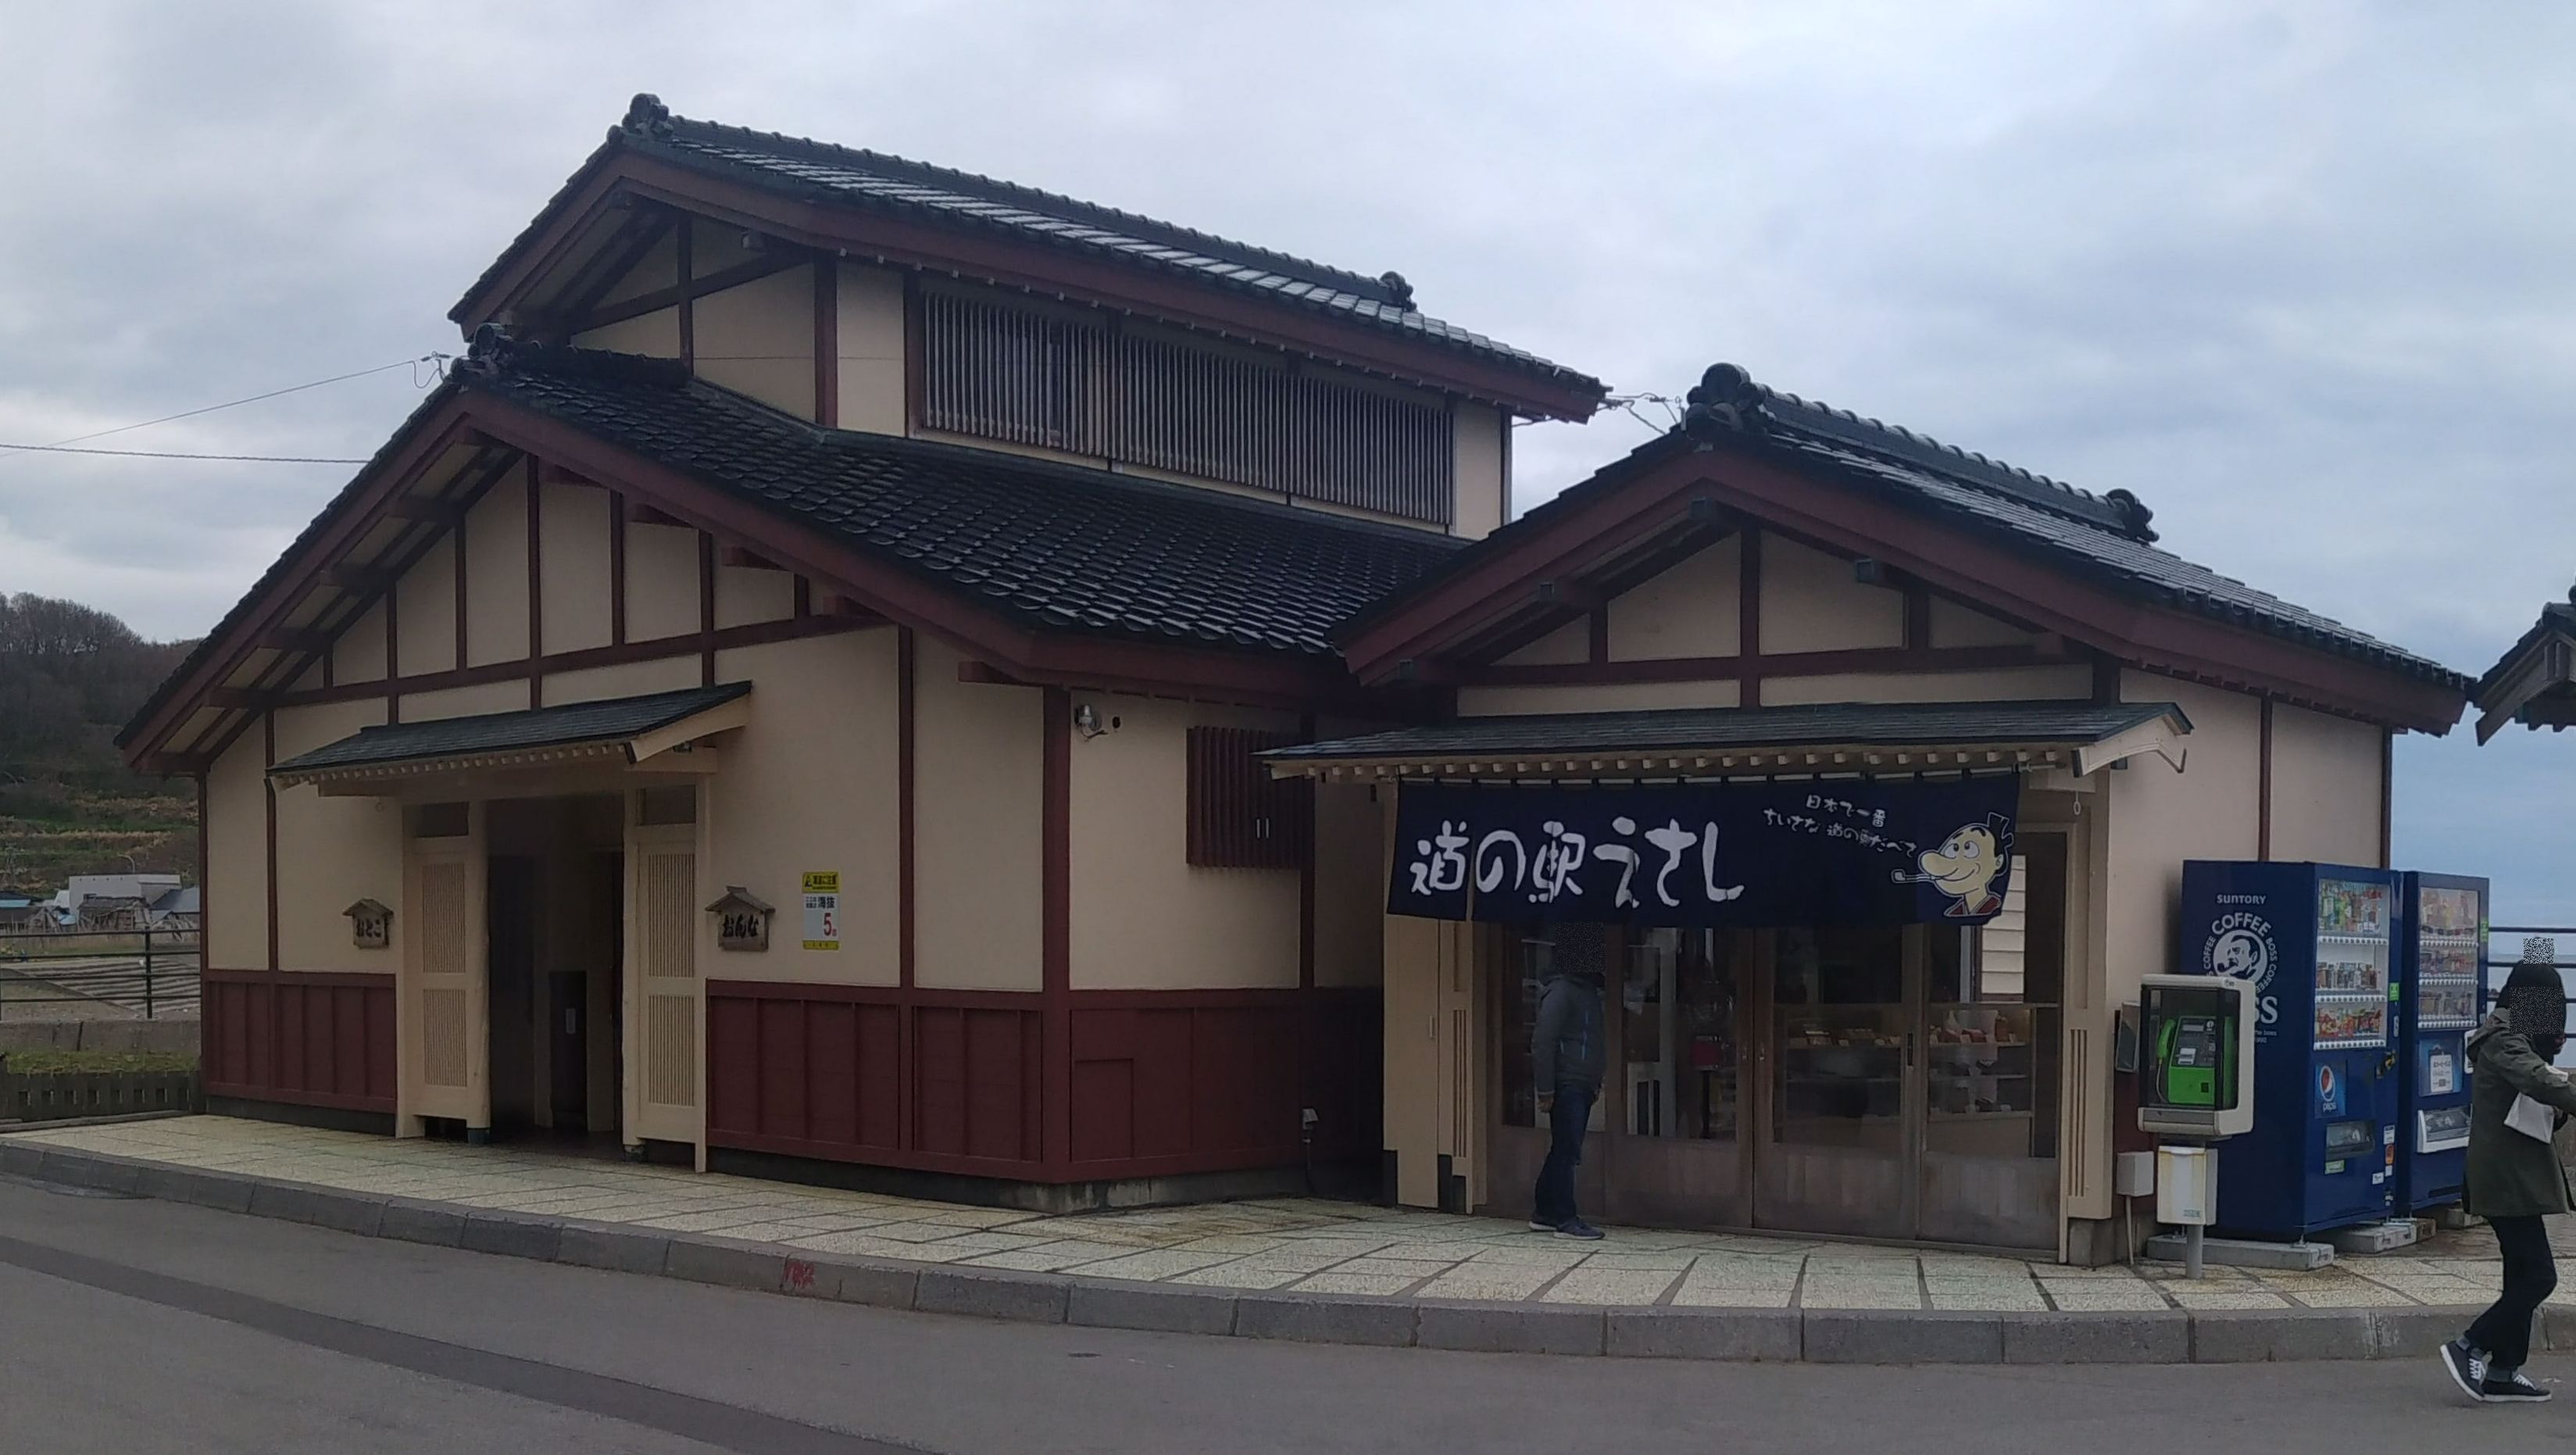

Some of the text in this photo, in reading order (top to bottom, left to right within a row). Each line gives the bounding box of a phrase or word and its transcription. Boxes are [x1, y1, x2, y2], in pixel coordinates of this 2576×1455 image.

[1806, 794, 1886, 828] 日本で一番
[1409, 816, 1745, 909] 道の駅えさし
[2217, 894, 2267, 905] SUNTORY
[356, 918, 382, 938] おとこ
[722, 913, 759, 939] おんな
[2211, 912, 2272, 937] COFFEE
[2203, 937, 2217, 970] COFFEE
[2265, 937, 2278, 962] BOSS
